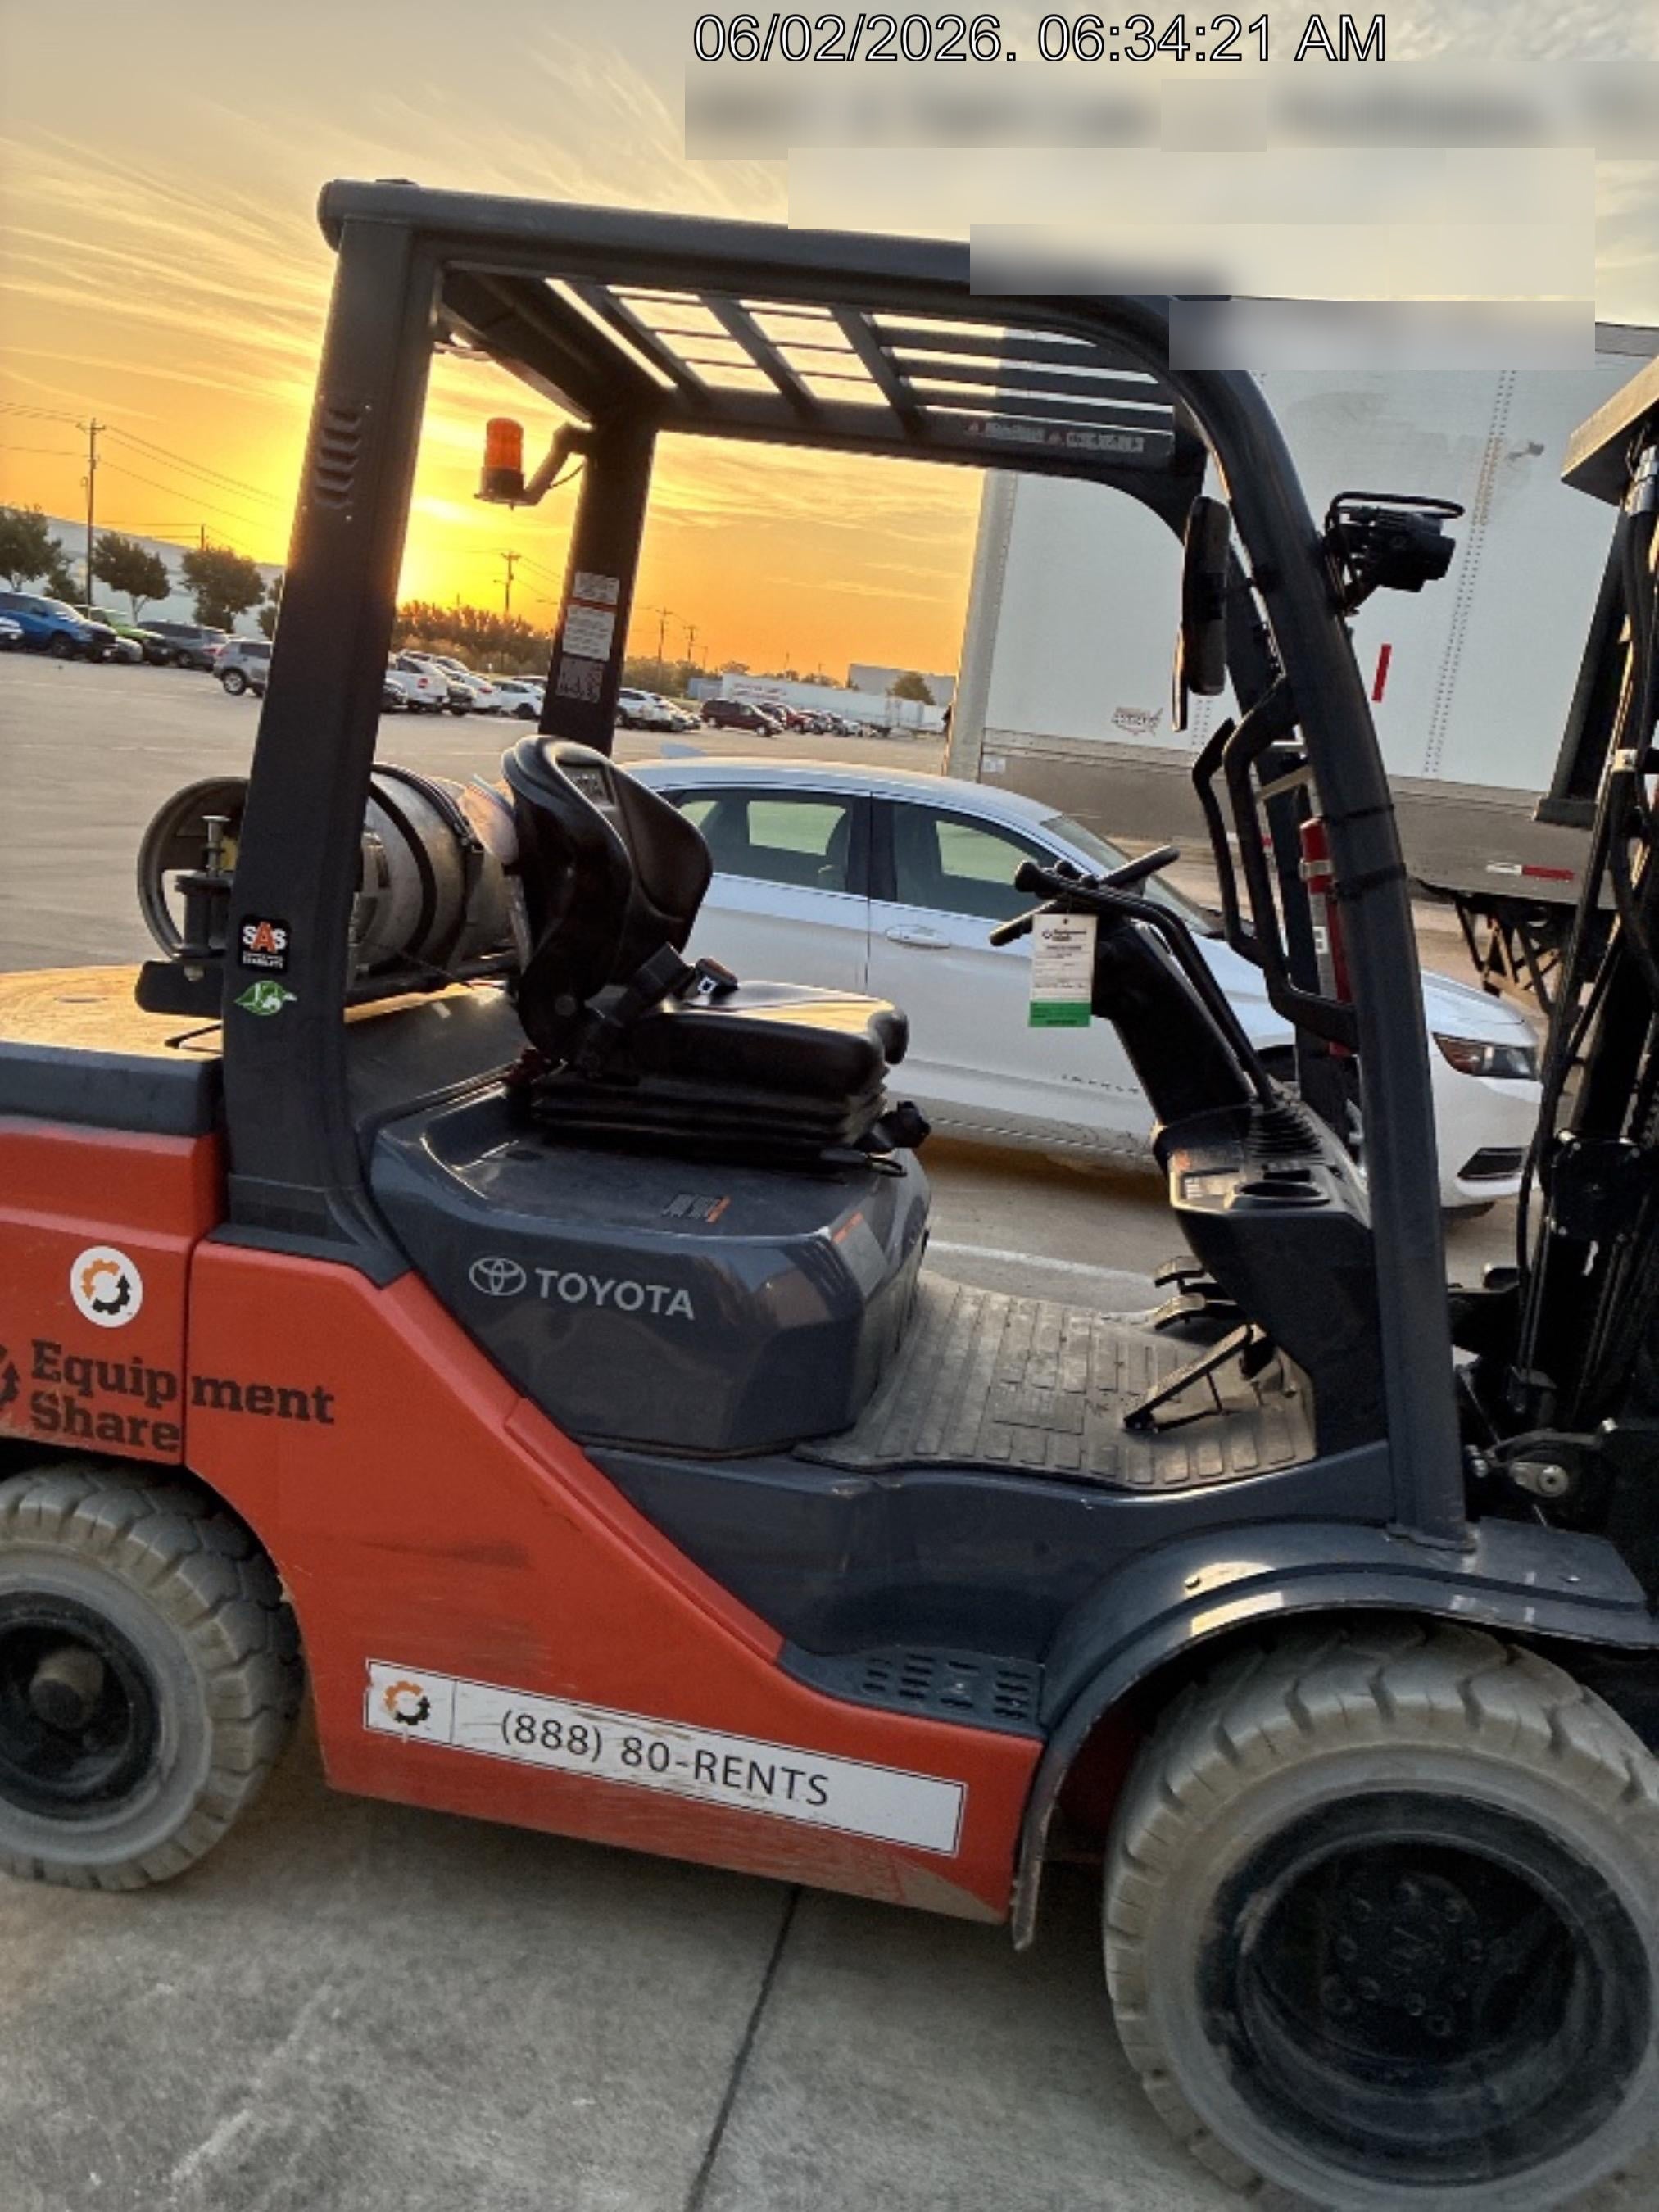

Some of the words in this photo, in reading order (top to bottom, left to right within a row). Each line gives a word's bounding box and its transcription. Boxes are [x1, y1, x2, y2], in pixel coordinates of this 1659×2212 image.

[243, 922, 287, 954] SAS
[535, 1267, 696, 1321] TOYOTA
[29, 1390, 180, 1452] Share
[501, 1709, 601, 1763] (888)
[620, 1735, 830, 1806] 80-RENTS
